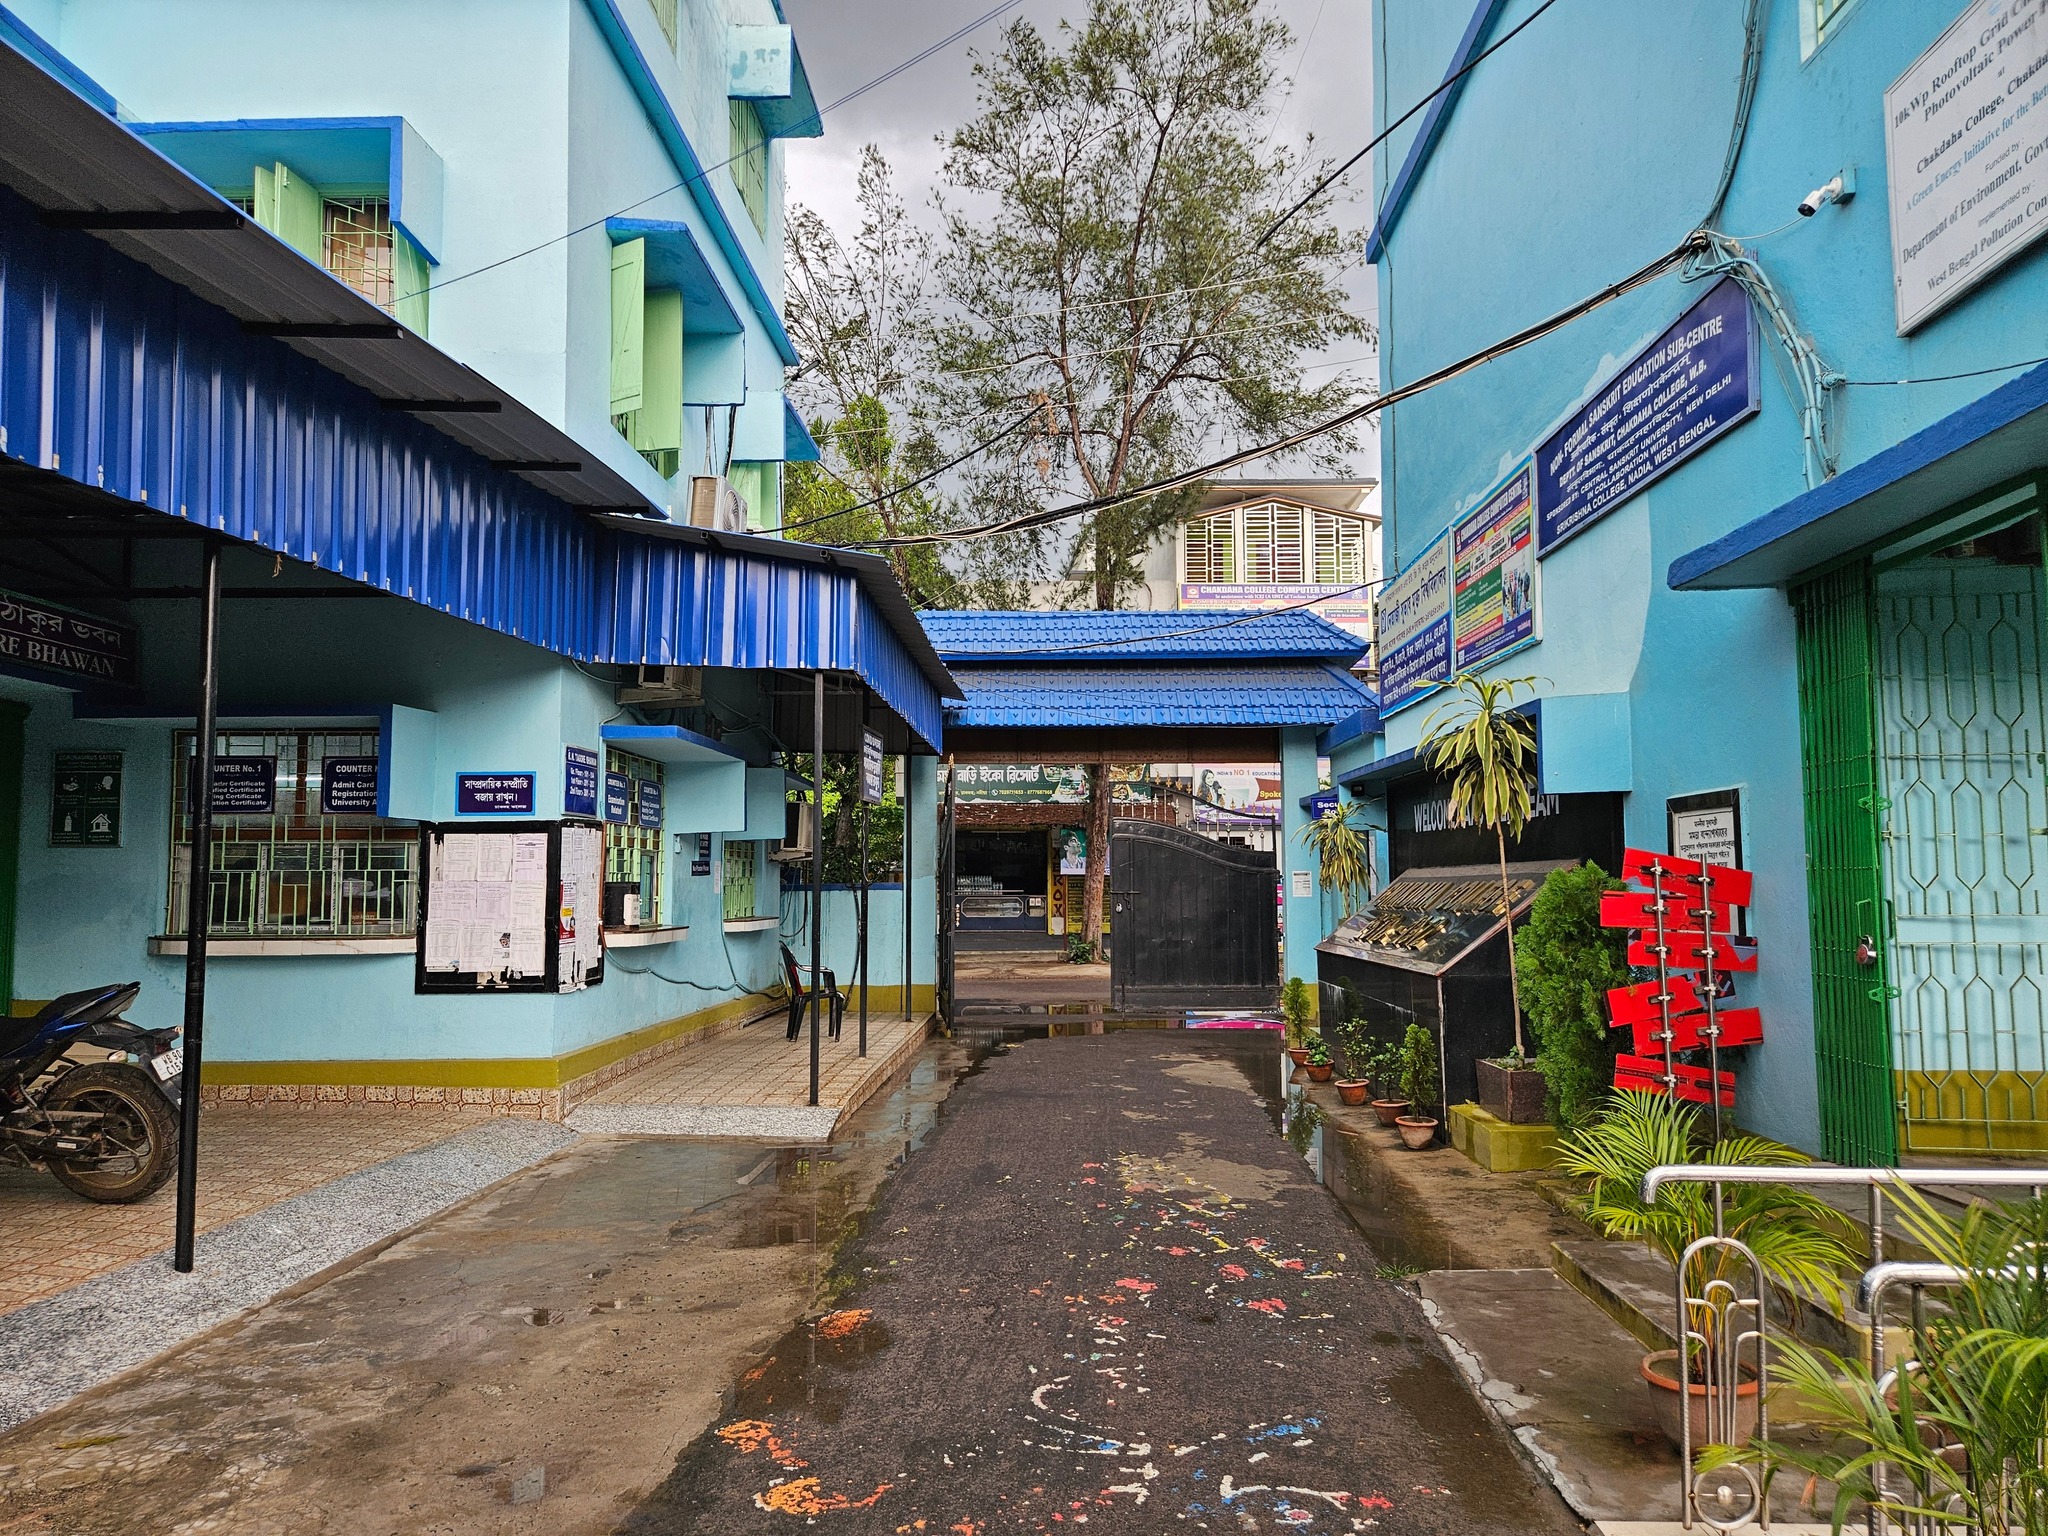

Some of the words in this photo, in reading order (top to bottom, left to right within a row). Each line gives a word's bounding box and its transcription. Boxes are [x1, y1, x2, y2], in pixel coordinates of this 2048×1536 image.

[1894, 91, 1929, 129] 10kWp
[1932, 46, 1976, 93] Rooftop
[1980, 12, 2008, 46] Grid
[1924, 51, 1994, 122] Photovoltaic
[1997, 11, 2037, 55] Power
[1998, 66, 2005, 78] at
[1917, 129, 1963, 174] Chakdaha
[1965, 95, 2005, 132] College,
[2007, 49, 2048, 95] Chakda
[1912, 183, 1934, 207] Green
[1935, 159, 1962, 188] Energy
[1964, 127, 2000, 164] Initiative
[2002, 114, 2014, 132] for
[2016, 101, 2030, 119] the
[1985, 146, 2010, 173] Funded
[2011, 141, 2021, 154] by
[1903, 218, 1948, 264] Department
[1949, 205, 1959, 224] of
[1960, 159, 2022, 217] Environment,
[1978, 189, 2020, 228] Implemented
[2021, 183, 2031, 194] by
[1927, 270, 1947, 290] West
[1948, 244, 1978, 277] Bengal
[1980, 213, 2024, 253] Pollution
[2026, 194, 2048, 217] Con
[1564, 424, 1589, 457] FORMAL
[1588, 383, 1622, 429] SANSKRIT
[1622, 348, 1666, 396] EDUCATION
[1667, 315, 1723, 359] SUB-CENTRE
[1576, 460, 1584, 474] OF
[1584, 435, 1616, 468] SANSKRIT,
[1616, 403, 1653, 442] CHAKDAHA
[1653, 374, 1688, 411] COLLEGE,
[1688, 358, 1707, 381] W.B.
[1546, 498, 1571, 522] SPONSORED
[1571, 490, 1580, 503] BY:
[1580, 470, 1608, 494] CENTRAL
[1608, 447, 1640, 475] SANSKRIT
[1640, 413, 1683, 451] UNIVERSITY,
[1685, 393, 1704, 416] NEW
[1705, 373, 1732, 399] DELHI
[1556, 505, 1592, 535] SRIKRISHNA
[1592, 480, 1627, 509] COLLEGE,
[1628, 461, 1654, 486] NADIA,
[1654, 443, 1677, 466] WEST
[1678, 414, 1716, 448] BENGAL
[1586, 489, 1594, 501] IN
[1594, 450, 1649, 495] COLLABORATION
[1649, 435, 1668, 455] WITH
[1200, 586, 1243, 594] CHAKDAHA
[1244, 586, 1277, 594] COLLEGE
[1277, 586, 1320, 594] COMPUTER
[0, 595, 64, 637] ঠাকুর
[70, 619, 121, 649] ভবন
[27, 640, 115, 678] BHAWAN
[332, 781, 355, 789] Admit
[336, 765, 373, 773] COUNTER
[464, 777, 501, 790] সাম্প্রদায়িক
[502, 776, 529, 790] সম্প্রীতি
[607, 778, 620, 786] COUNTER
[957, 765, 977, 785] বাড়ি
[979, 765, 1004, 783] ইকো
[1007, 763, 1040, 785] রিসোর্ট
[332, 790, 378, 798] Registration
[332, 799, 370, 807] University
[474, 792, 494, 802] বজায়
[608, 794, 625, 806] Examination
[643, 786, 654, 795] COUNTER
[161, 1054, 173, 1065] WB
[171, 1049, 183, 1061] 90
[166, 1060, 183, 1076] C15
